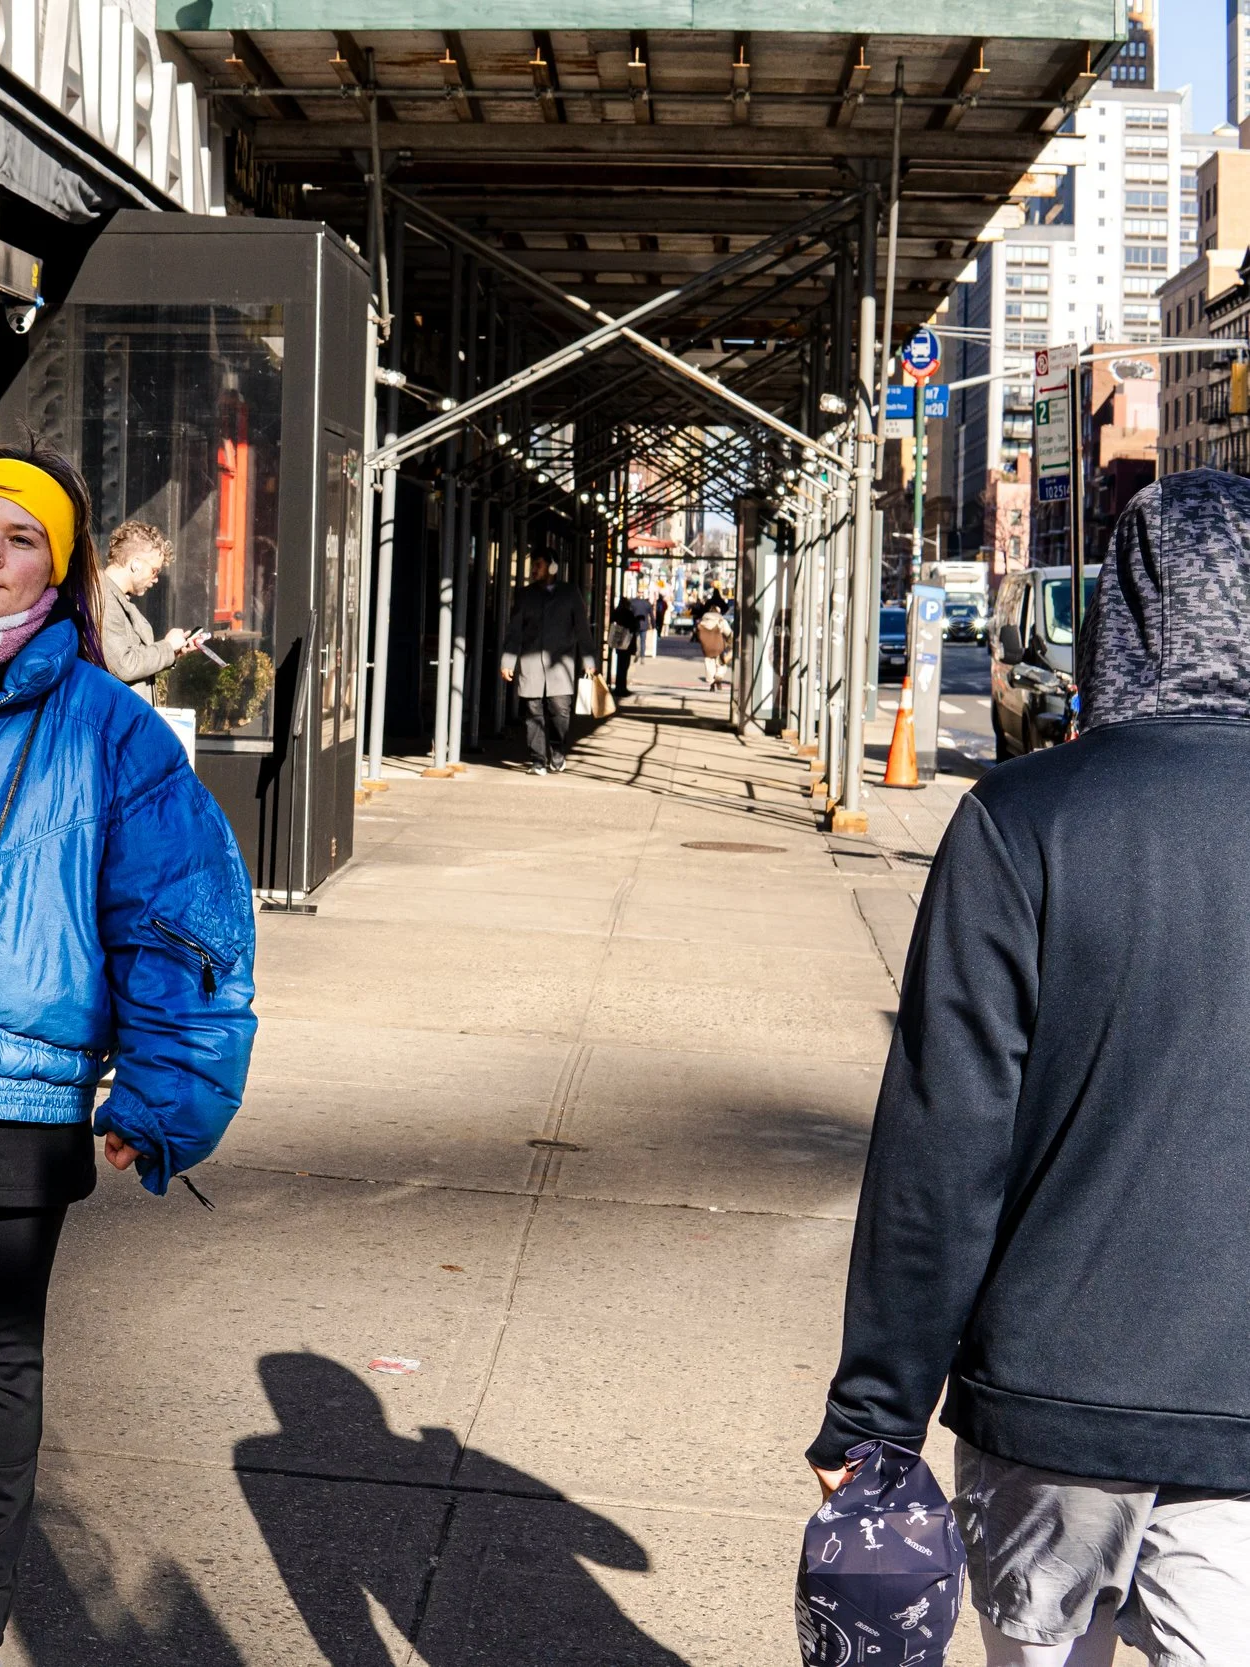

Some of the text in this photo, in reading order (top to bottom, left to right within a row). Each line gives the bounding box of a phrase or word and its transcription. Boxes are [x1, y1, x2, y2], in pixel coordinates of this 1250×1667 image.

[925, 387, 940, 399] M7
[924, 402, 944, 416] M20
[1039, 402, 1047, 424] 2
[925, 600, 939, 620] P
